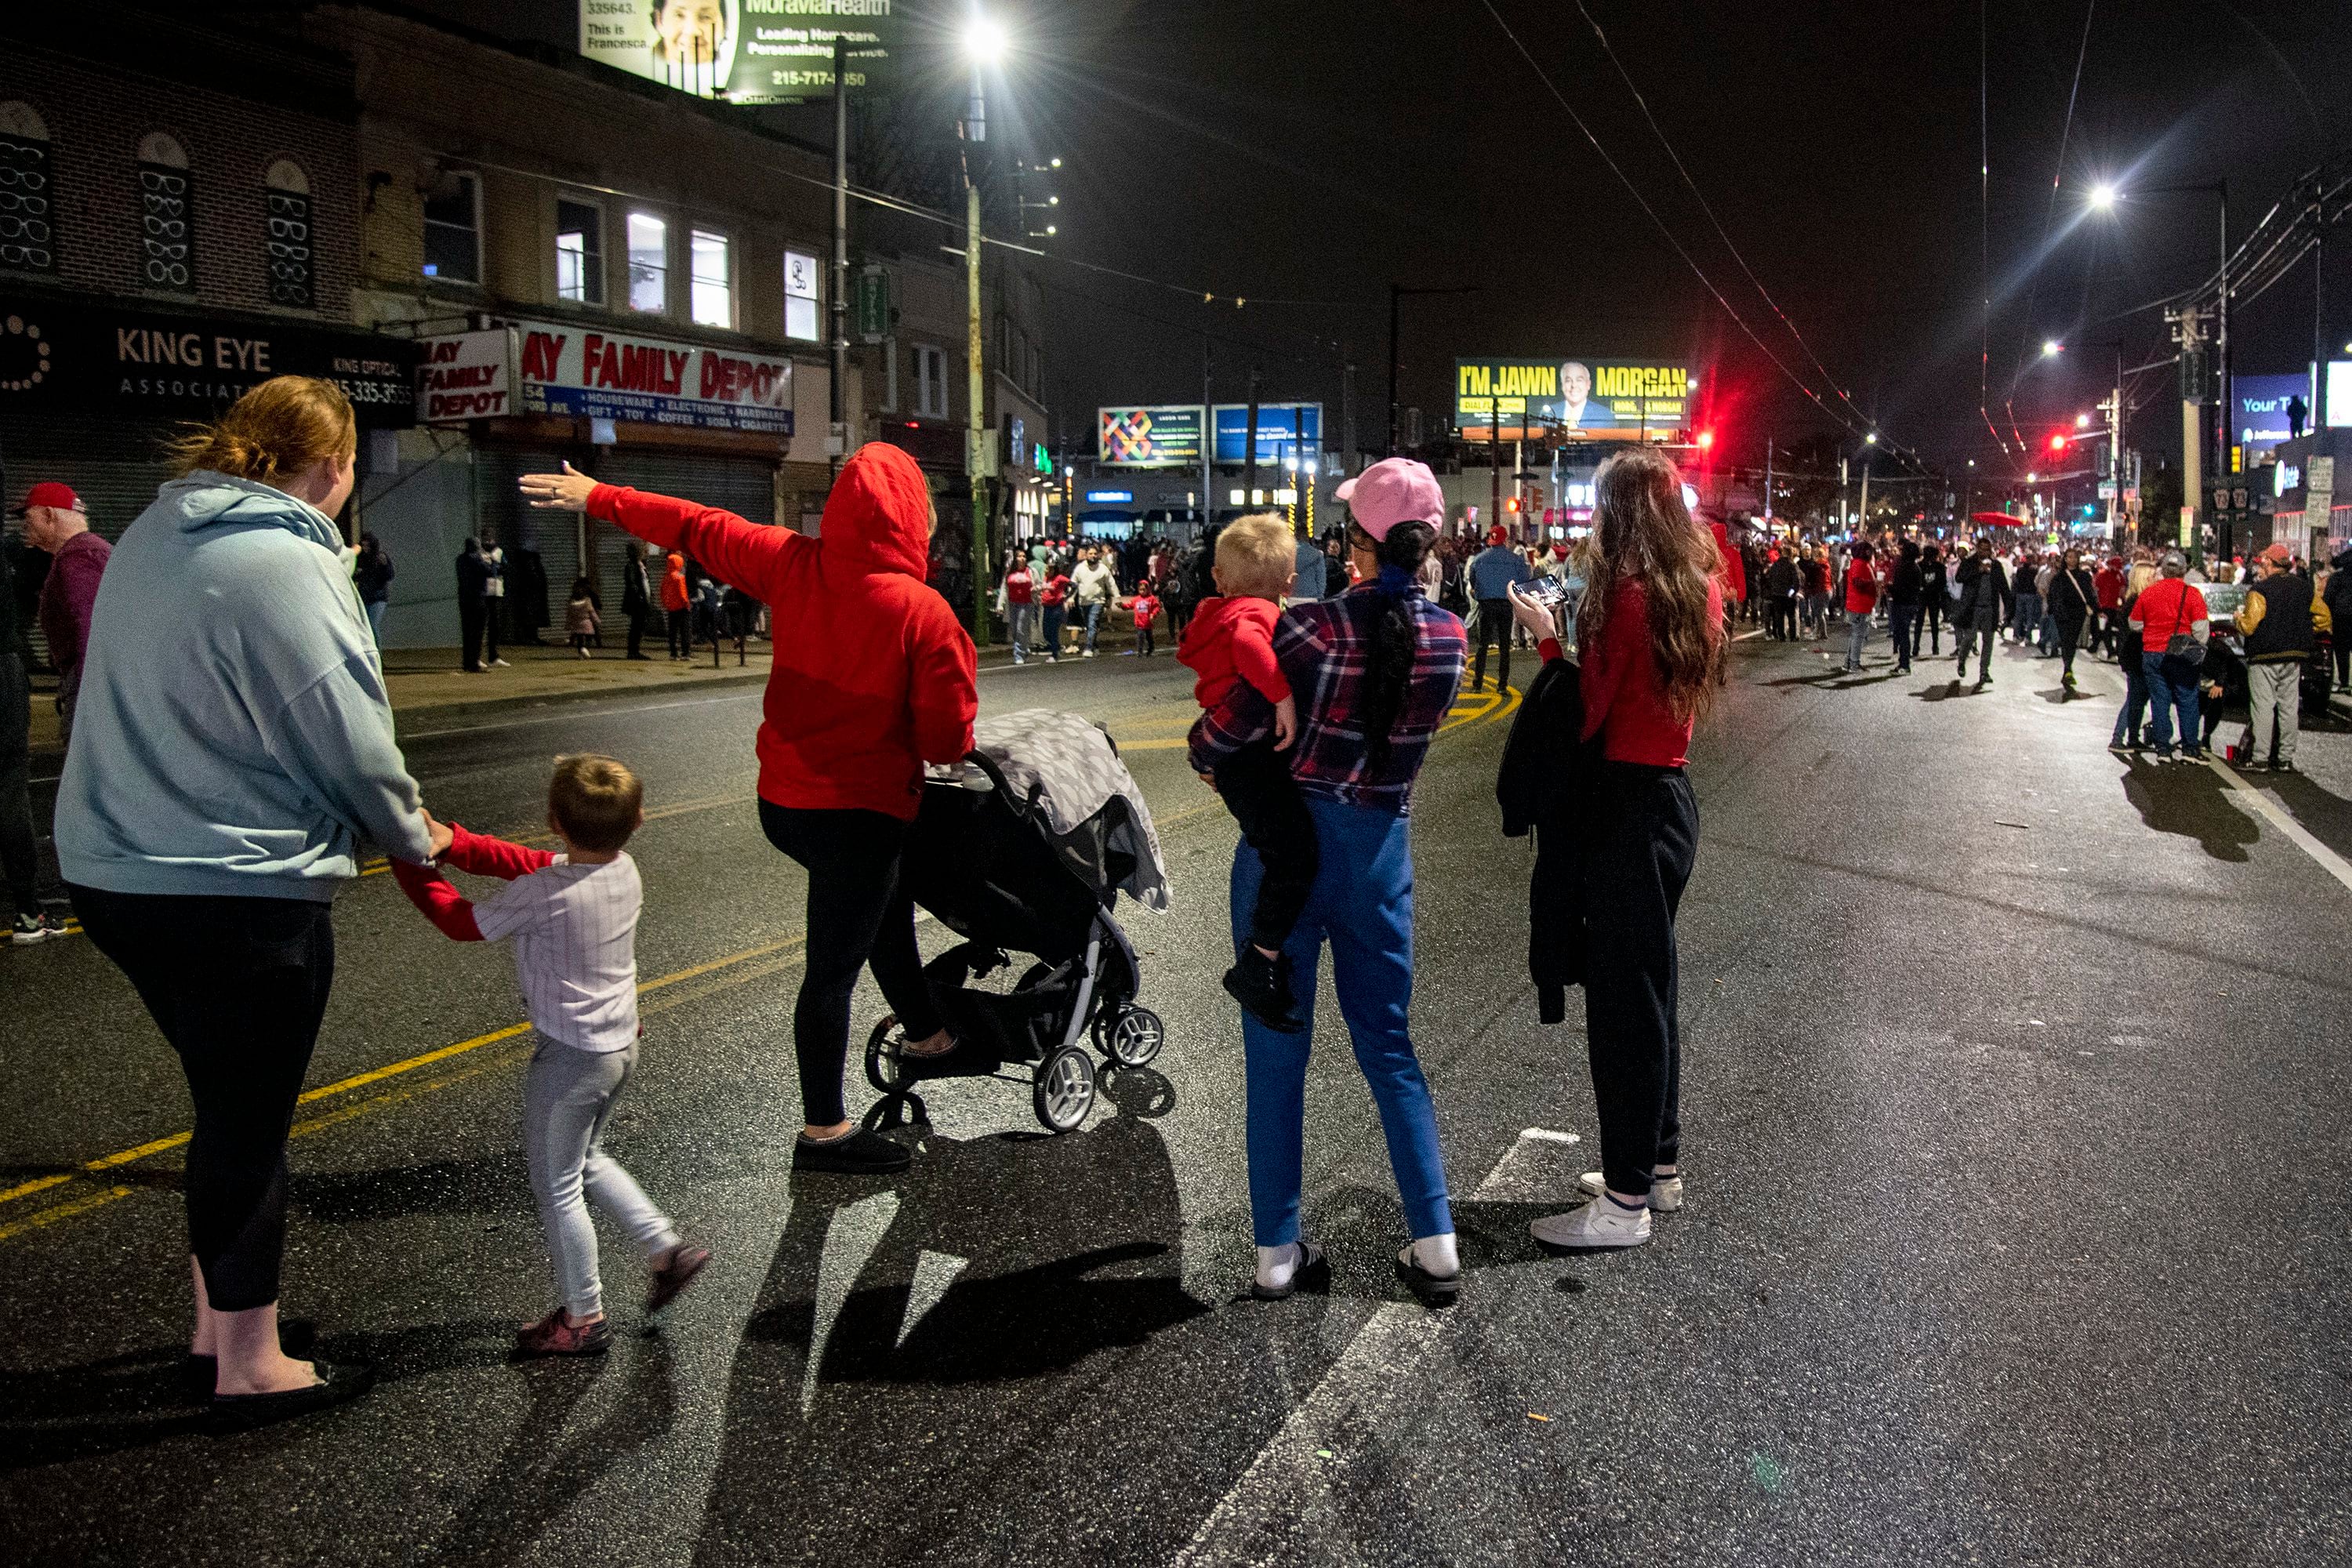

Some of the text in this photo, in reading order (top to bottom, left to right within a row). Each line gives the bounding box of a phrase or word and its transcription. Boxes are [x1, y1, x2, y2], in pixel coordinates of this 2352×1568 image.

[588, 24, 625, 35] This is
[757, 27, 809, 42] Leading
[588, 38, 650, 49] Francesca.
[747, 42, 835, 59] Personalizing
[118, 328, 271, 372] KING EYE
[419, 365, 499, 391] FAMILY
[522, 331, 789, 407] AY FAMILY DEPOT
[120, 378, 245, 400] ASSOCIAT
[1460, 365, 1687, 397] I'M JAWN MORGAN
[430, 391, 506, 416] DEPOT
[2242, 397, 2278, 412] Your
[625, 409, 646, 420] TOY
[657, 412, 694, 425] COFFEE
